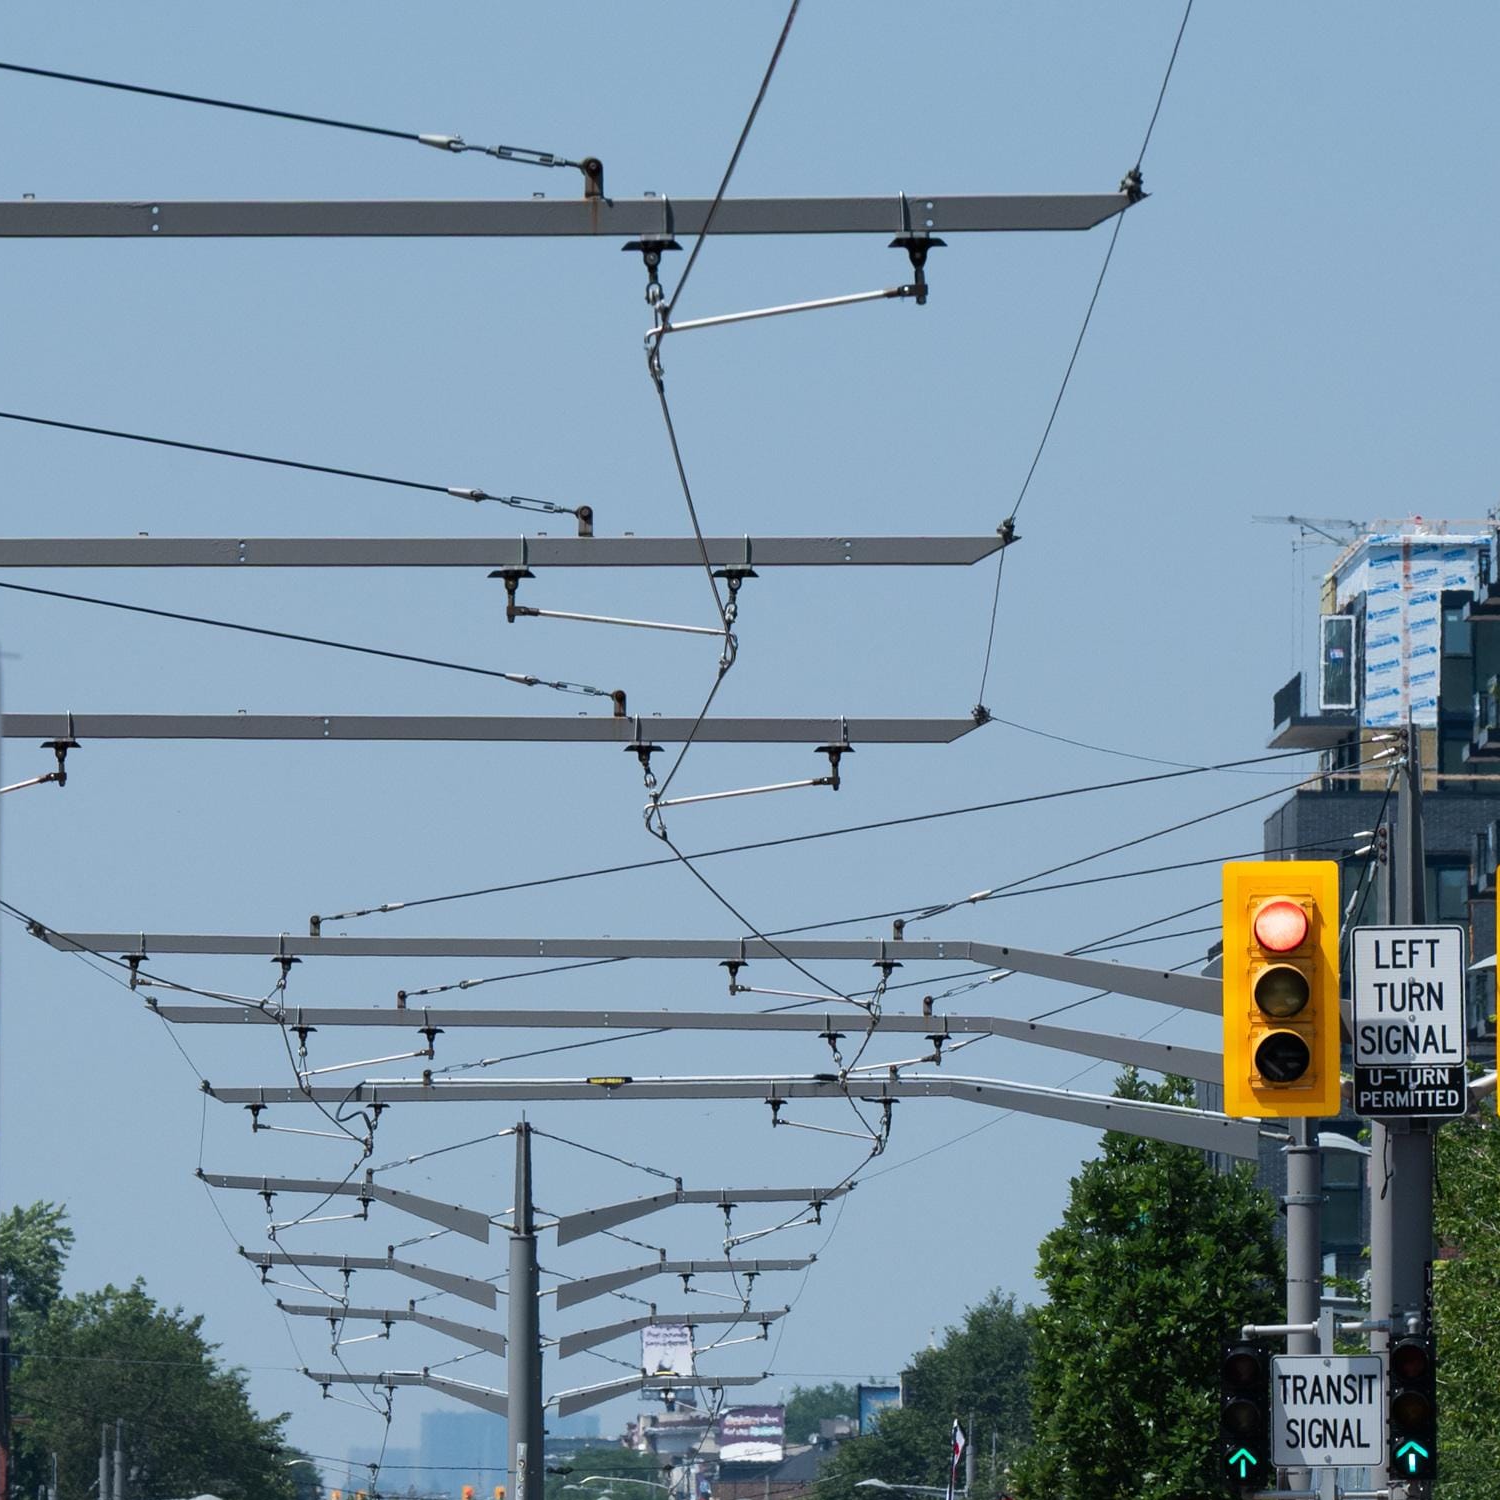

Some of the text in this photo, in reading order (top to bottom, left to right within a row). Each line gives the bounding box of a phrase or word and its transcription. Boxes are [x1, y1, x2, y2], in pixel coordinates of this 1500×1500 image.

[1375, 939, 1439, 969] LEFT
[1373, 982, 1443, 1012] TURN
[1360, 1025, 1457, 1054] SIGNAL
[1370, 1069, 1449, 1086] U-TURN
[1360, 1090, 1459, 1107] PERMITTED
[1278, 1374, 1377, 1405] TRANSIT
[1286, 1418, 1370, 1448] SIGNAL
